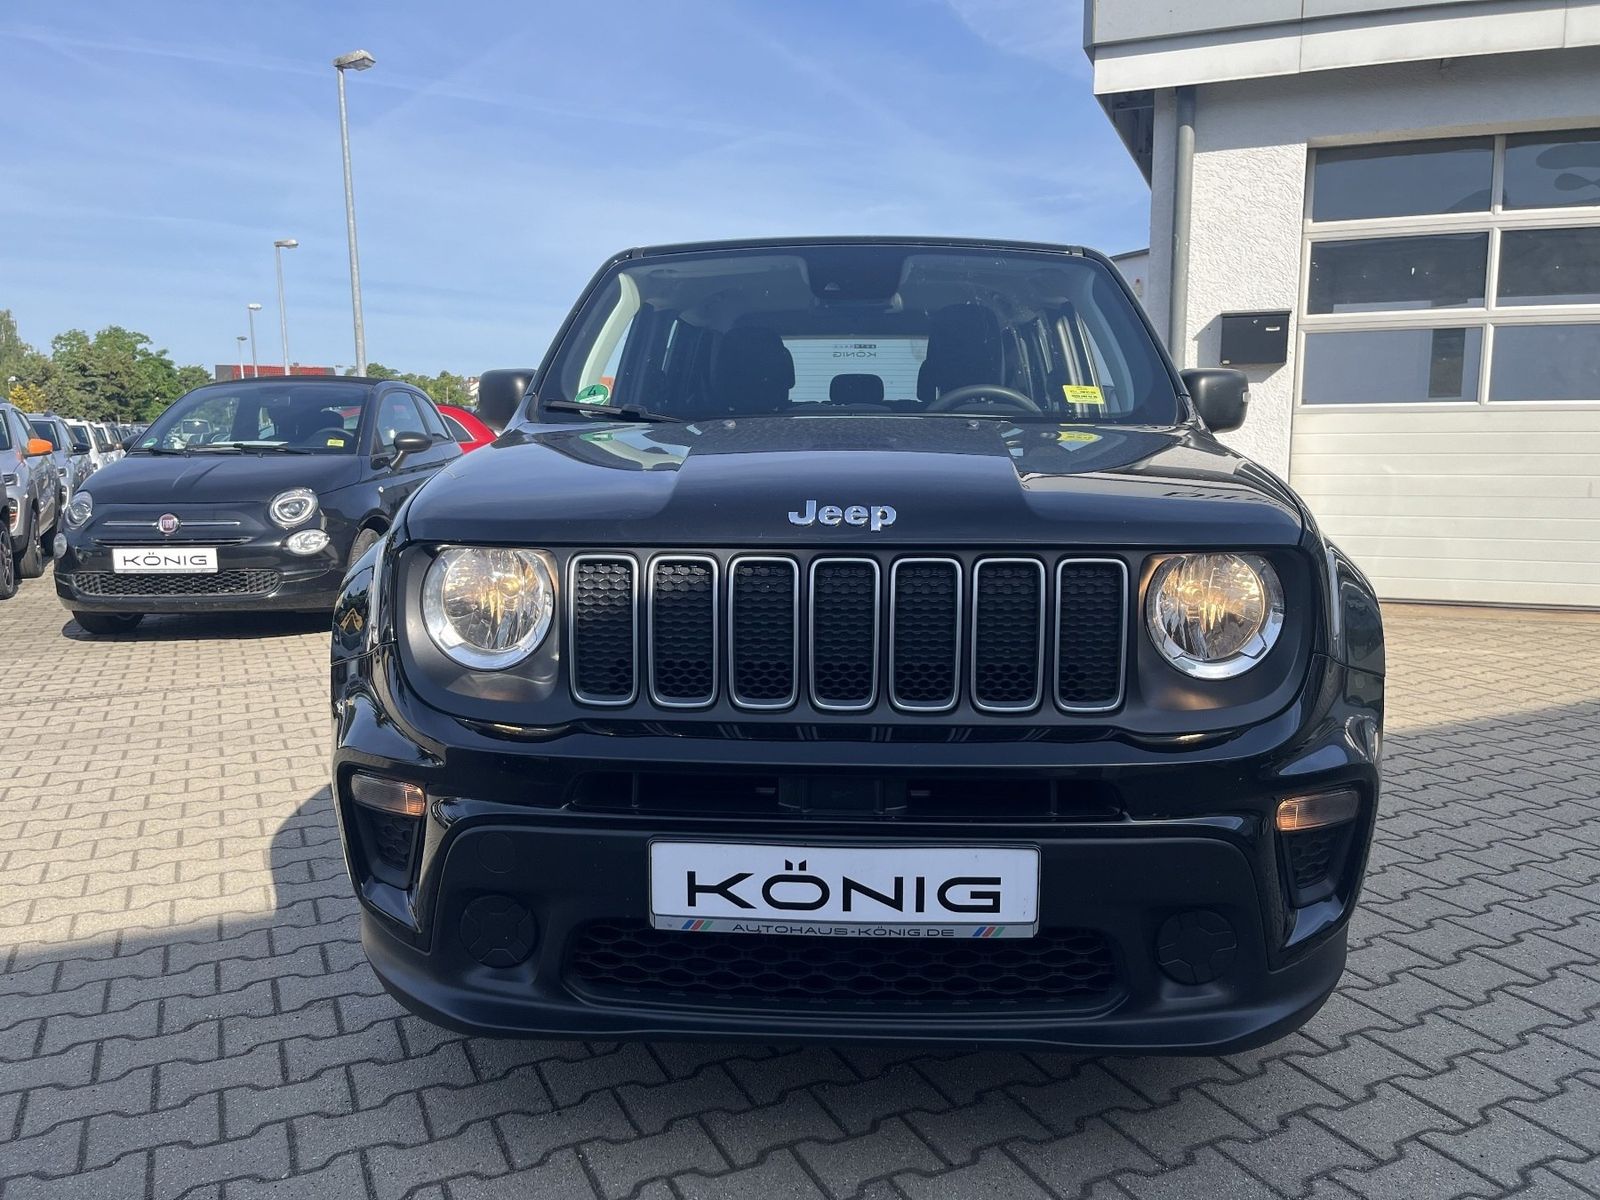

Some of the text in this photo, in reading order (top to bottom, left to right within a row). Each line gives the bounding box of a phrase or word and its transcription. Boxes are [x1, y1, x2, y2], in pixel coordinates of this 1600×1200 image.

[588, 385, 597, 396] 4
[788, 500, 897, 532] Jeep
[123, 552, 207, 566] KÖNIG
[687, 859, 1002, 914] KÖNIG
[731, 923, 955, 938] AUTOHAUS-KÖNIG.DE
